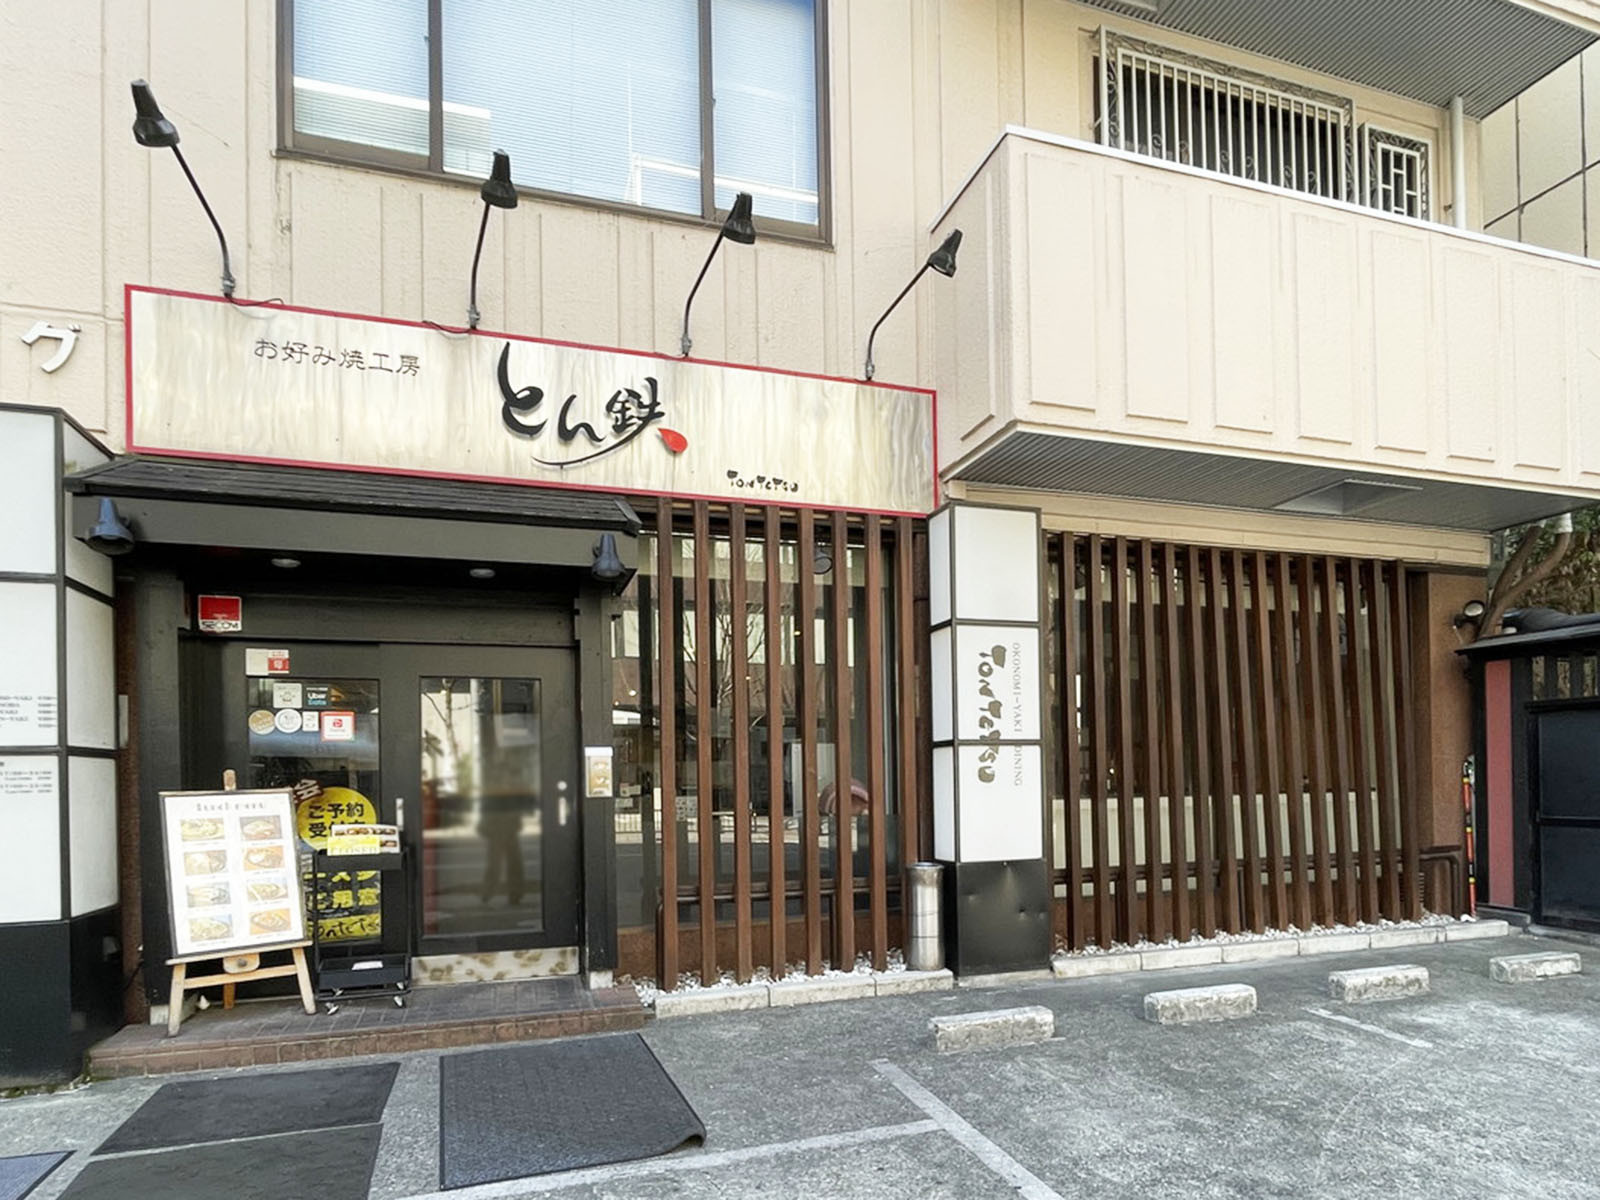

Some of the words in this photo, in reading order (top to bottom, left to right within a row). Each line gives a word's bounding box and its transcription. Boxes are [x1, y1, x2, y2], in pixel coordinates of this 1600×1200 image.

[20, 320, 82, 374] グ
[254, 338, 421, 377] お好み焼工房
[497, 340, 666, 468] とん鉄
[307, 692, 327, 700] Uber
[308, 802, 365, 820] ご予約
